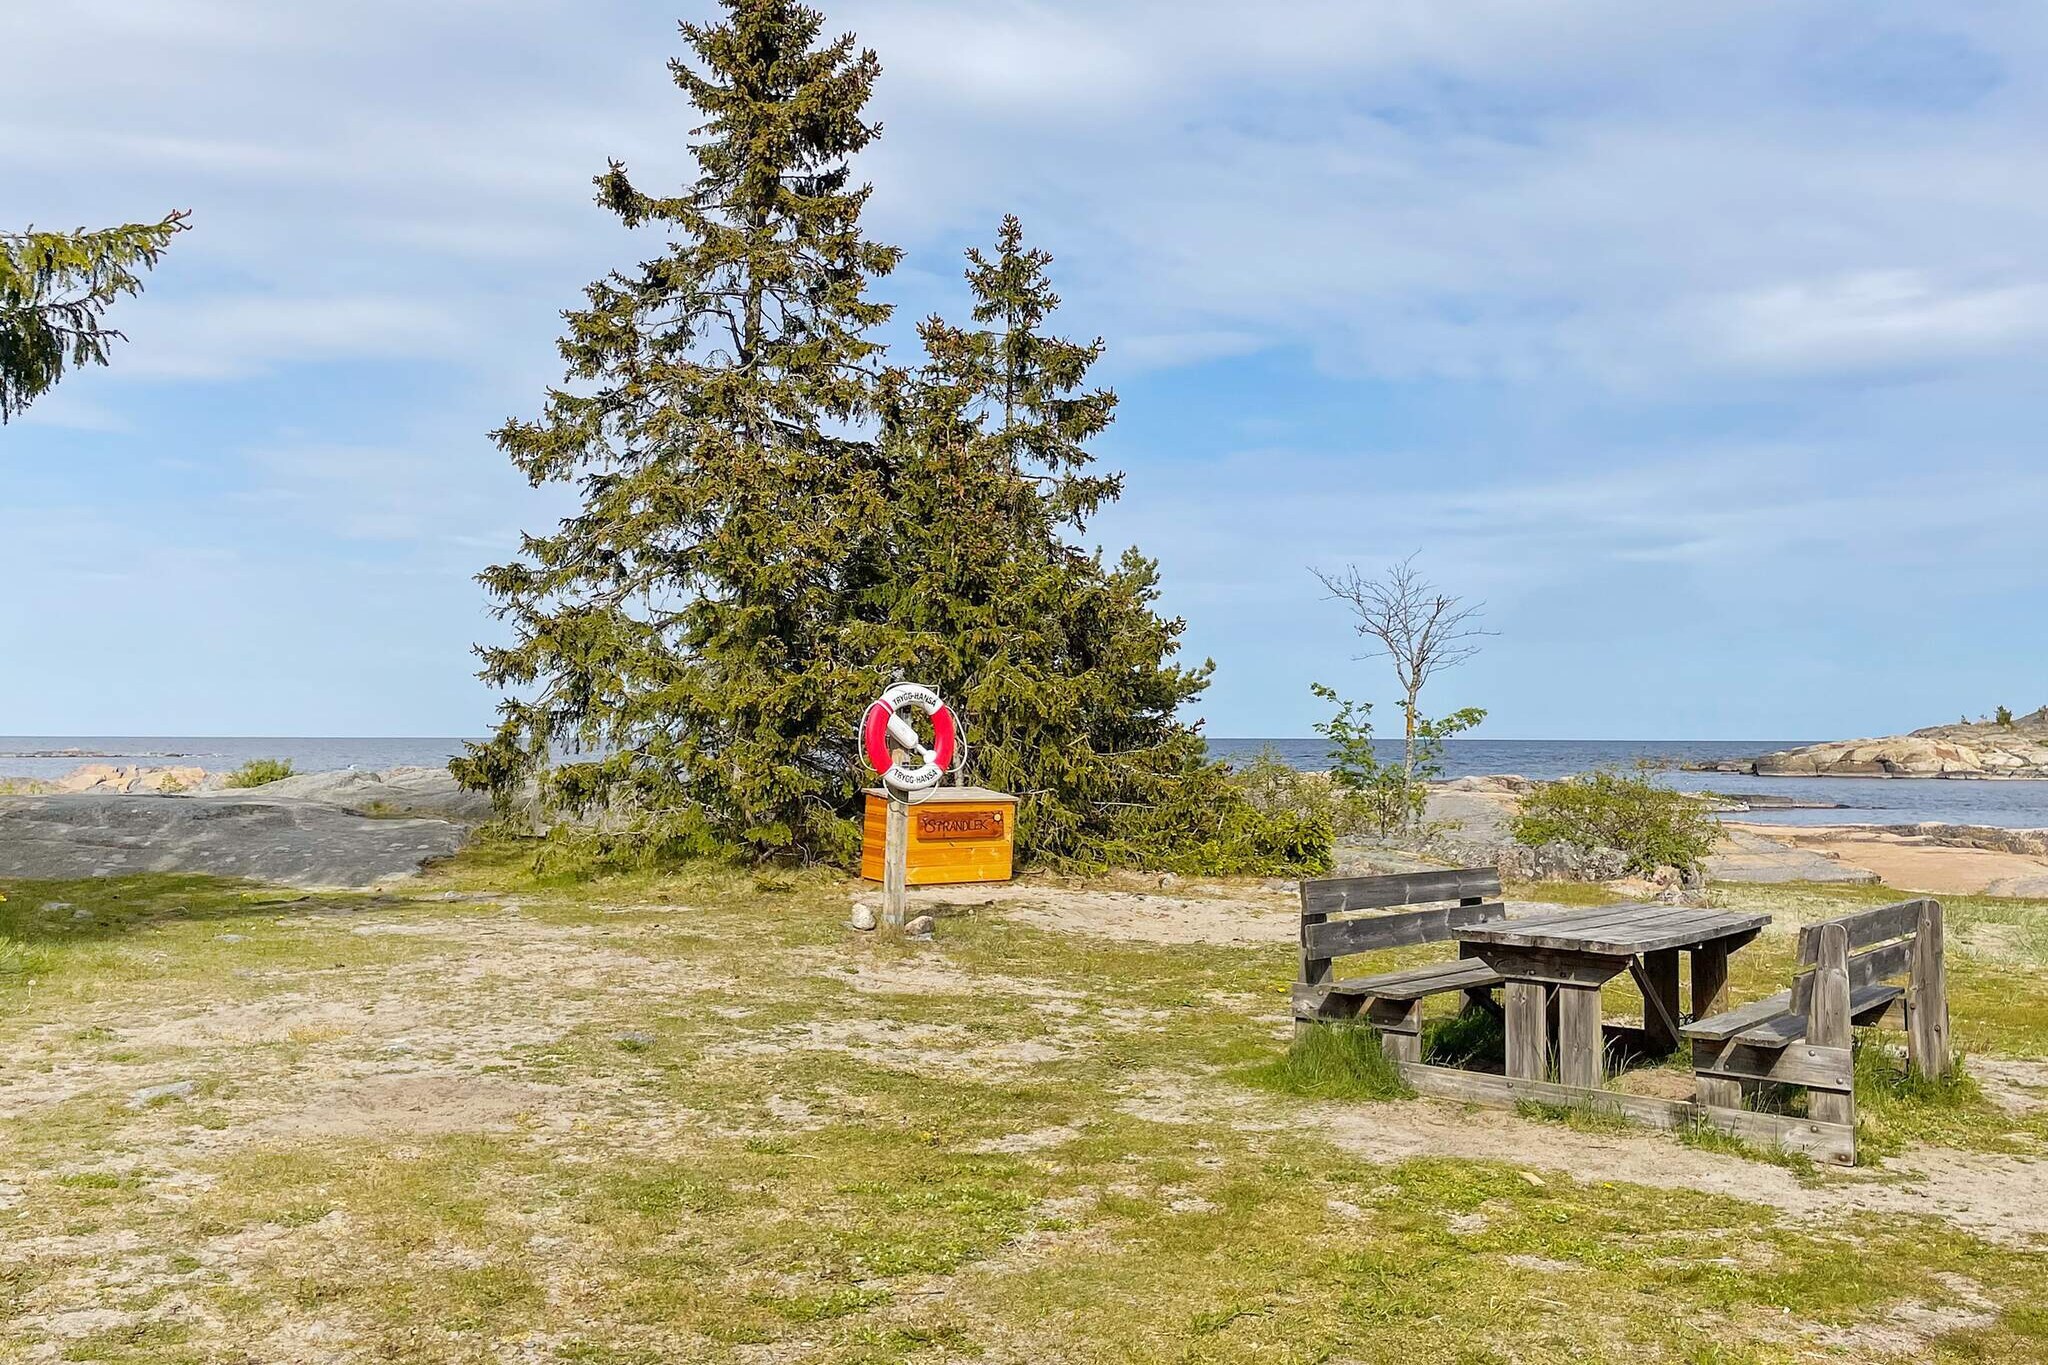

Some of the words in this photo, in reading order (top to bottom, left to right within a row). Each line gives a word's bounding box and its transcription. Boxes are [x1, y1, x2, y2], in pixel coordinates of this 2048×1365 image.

[893, 692, 936, 707] TRYGG-HANSA
[894, 769, 938, 784] TRYGG-HANSA
[924, 819, 989, 833] STRANDLEK
